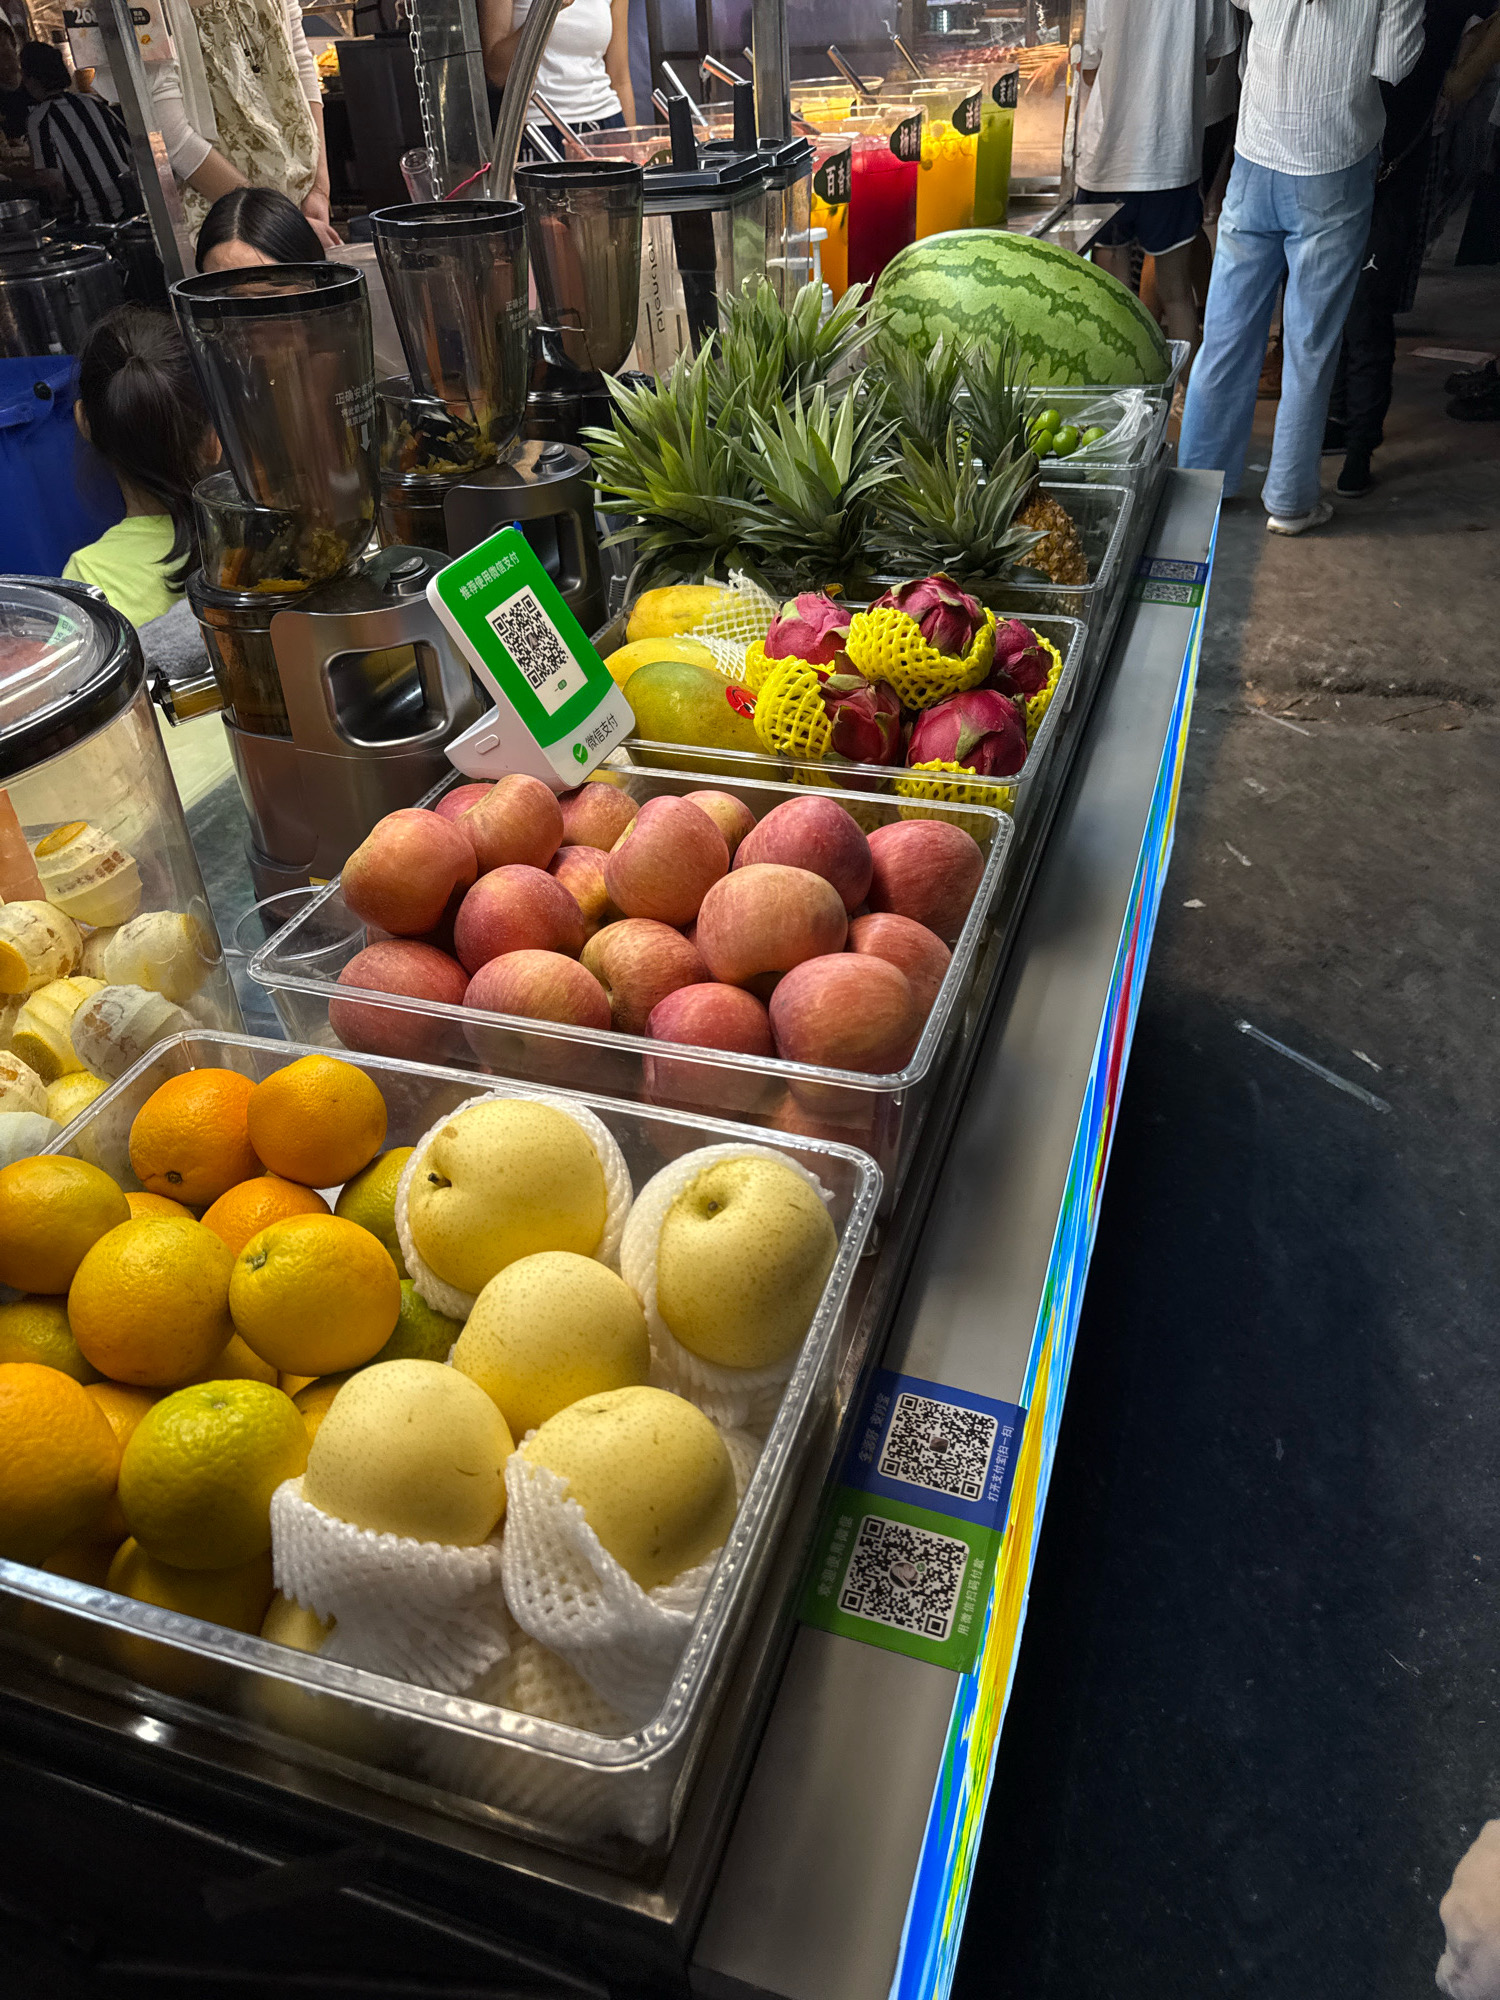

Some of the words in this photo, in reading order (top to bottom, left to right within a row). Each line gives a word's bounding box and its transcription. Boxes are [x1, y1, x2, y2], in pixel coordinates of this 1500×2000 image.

[459, 551, 521, 601] 推荐使用微信支付
[584, 712, 619, 752] 微信支付
[957, 1557, 986, 1636] 用微信扫码付款
